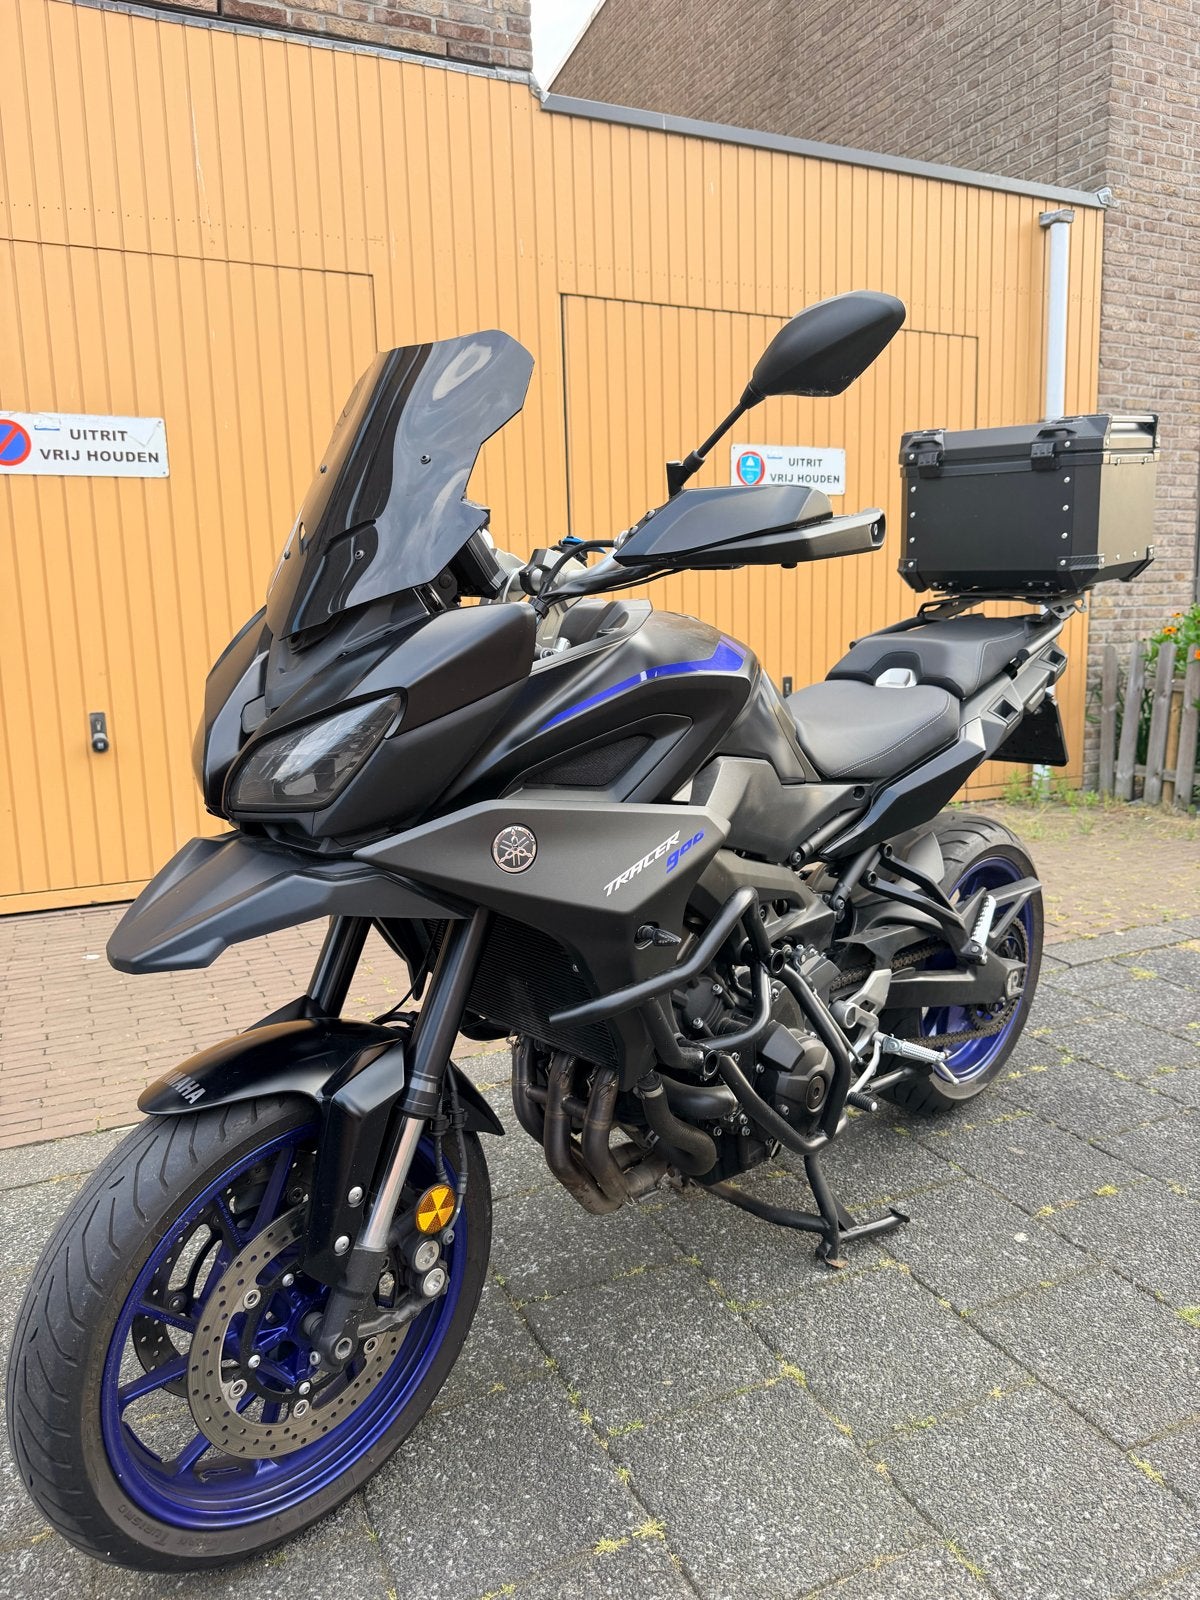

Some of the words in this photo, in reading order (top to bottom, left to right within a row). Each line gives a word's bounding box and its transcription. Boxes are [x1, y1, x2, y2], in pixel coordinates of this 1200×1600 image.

[69, 428, 128, 442] UITRIT
[40, 448, 80, 461] VRIJ
[87, 450, 160, 463] HOUDEN
[788, 457, 823, 467] UITRIT
[770, 473, 794, 483] VRIJ
[797, 474, 840, 484] HOUDEN
[666, 828, 704, 874] 900
[603, 830, 680, 897] TRACER
[161, 1071, 206, 1104] MAHA
